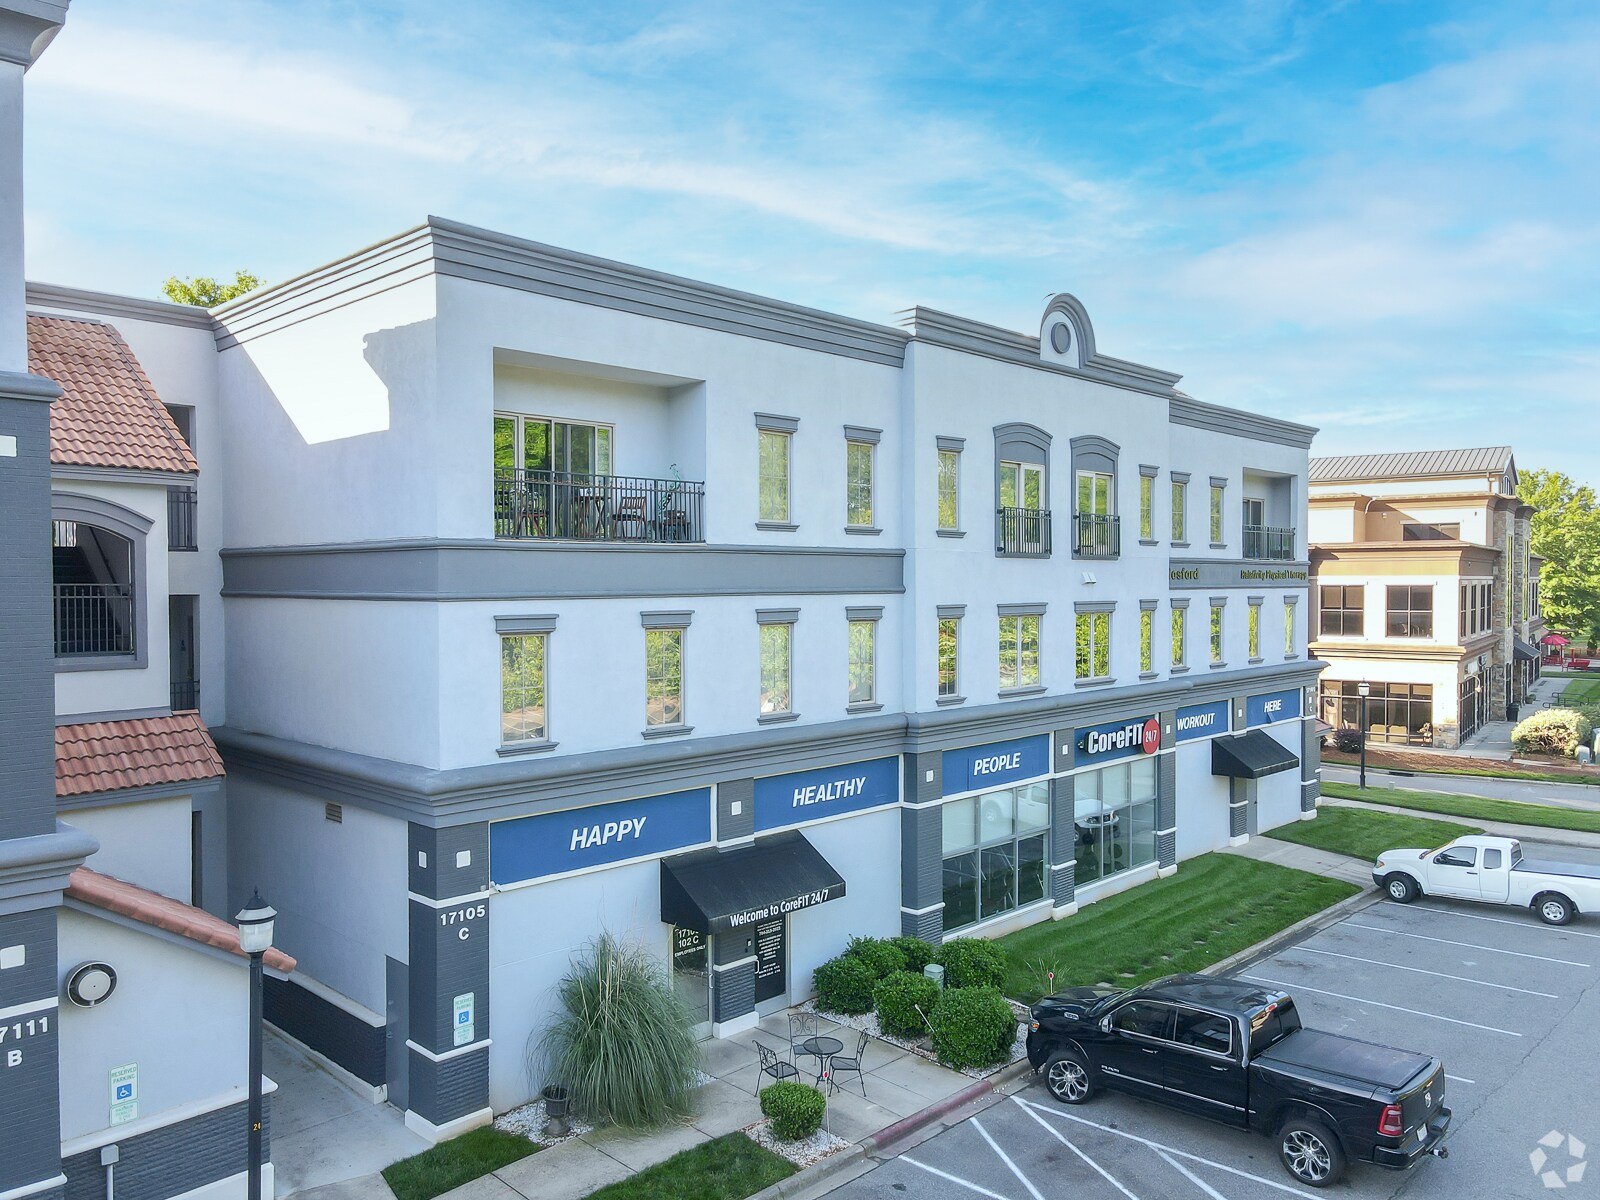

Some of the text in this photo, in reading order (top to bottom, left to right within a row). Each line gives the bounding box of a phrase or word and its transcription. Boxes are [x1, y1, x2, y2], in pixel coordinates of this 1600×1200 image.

[1169, 567, 1198, 580] osford
[1264, 699, 1282, 713] HERE
[1177, 713, 1216, 731] WORKOUT
[1087, 722, 1158, 754] CoreFIT 24/7
[973, 752, 1021, 776] PEOPLE
[792, 776, 867, 808] HEALTHY
[569, 816, 647, 851] HAPPY
[440, 904, 486, 926] 17105
[729, 907, 769, 927] Welcome
[769, 904, 779, 916] to
[780, 894, 810, 913] CoreFIT
[810, 888, 829, 904] 24/7
[458, 927, 470, 941] C
[678, 928, 699, 939] 1710
[678, 935, 699, 949] 102 C
[7, 1049, 23, 1067] B
[111, 1066, 137, 1078] RESERVED
[112, 1073, 136, 1084] PARKING
